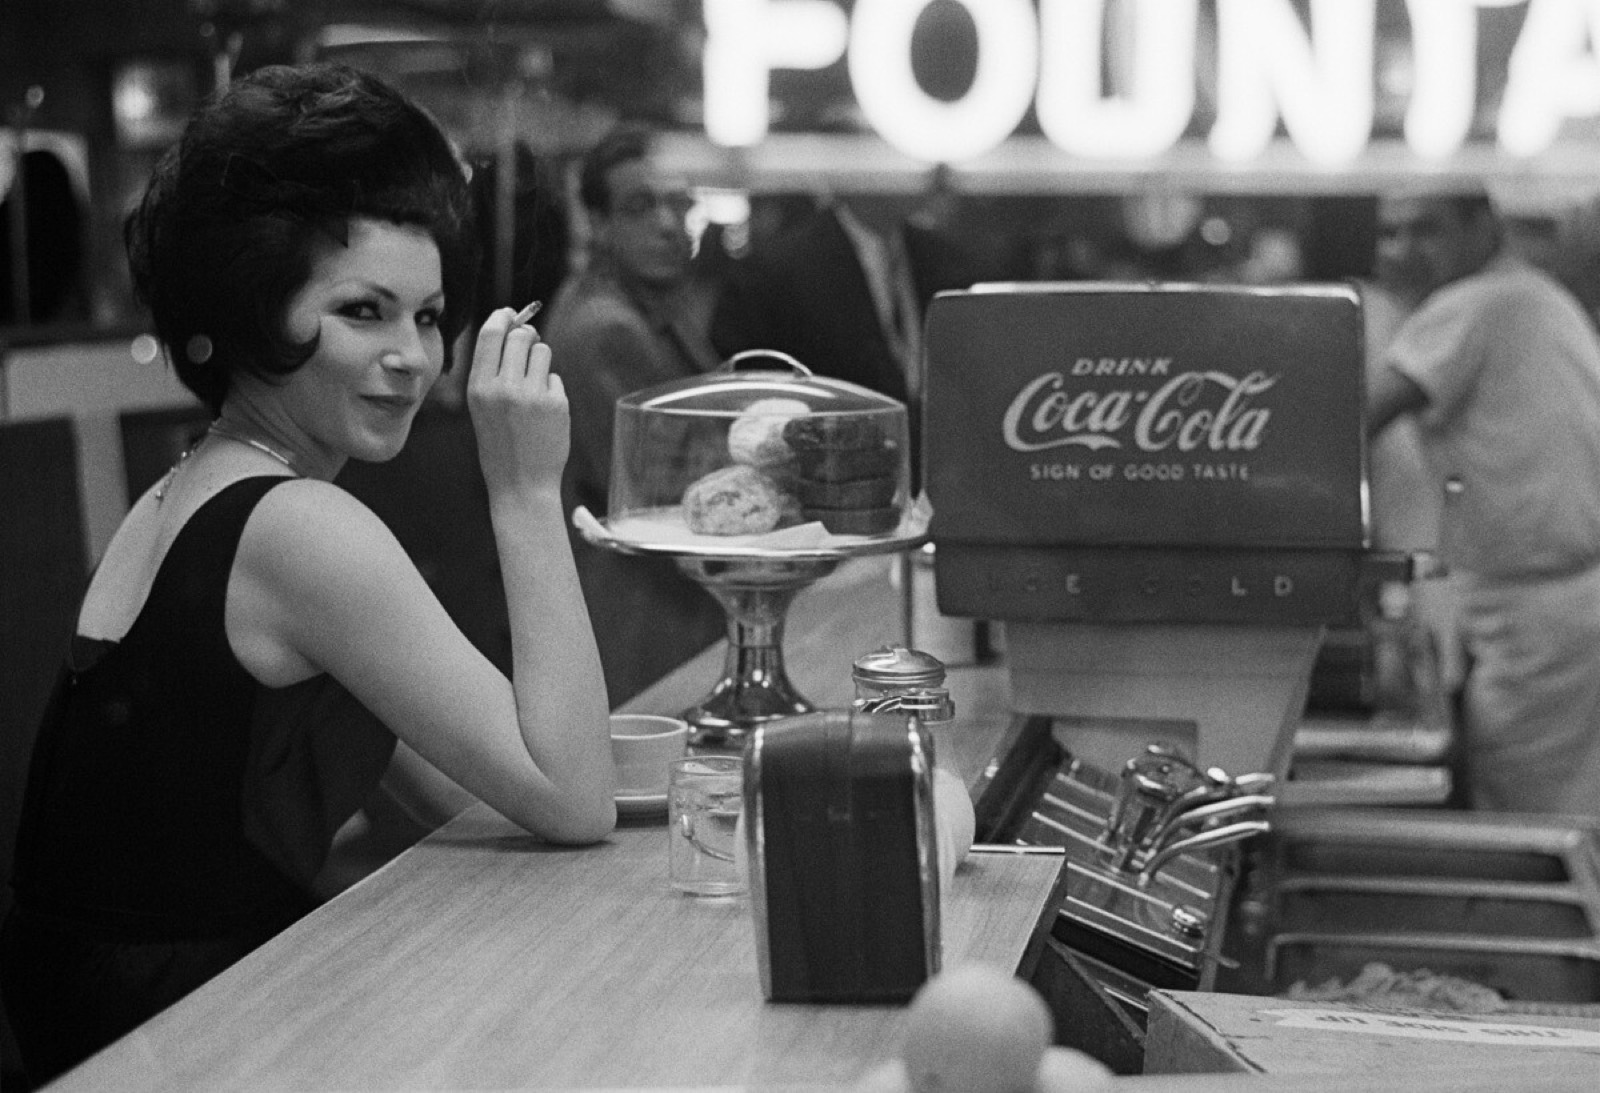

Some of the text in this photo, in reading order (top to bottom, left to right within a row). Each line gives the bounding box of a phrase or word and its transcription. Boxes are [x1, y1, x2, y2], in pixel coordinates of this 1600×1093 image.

[1072, 357, 1173, 376] DRINK
[1002, 371, 1280, 453] Coca-Cola
[1030, 463, 1249, 481] SIGN OF GOOD TASTE
